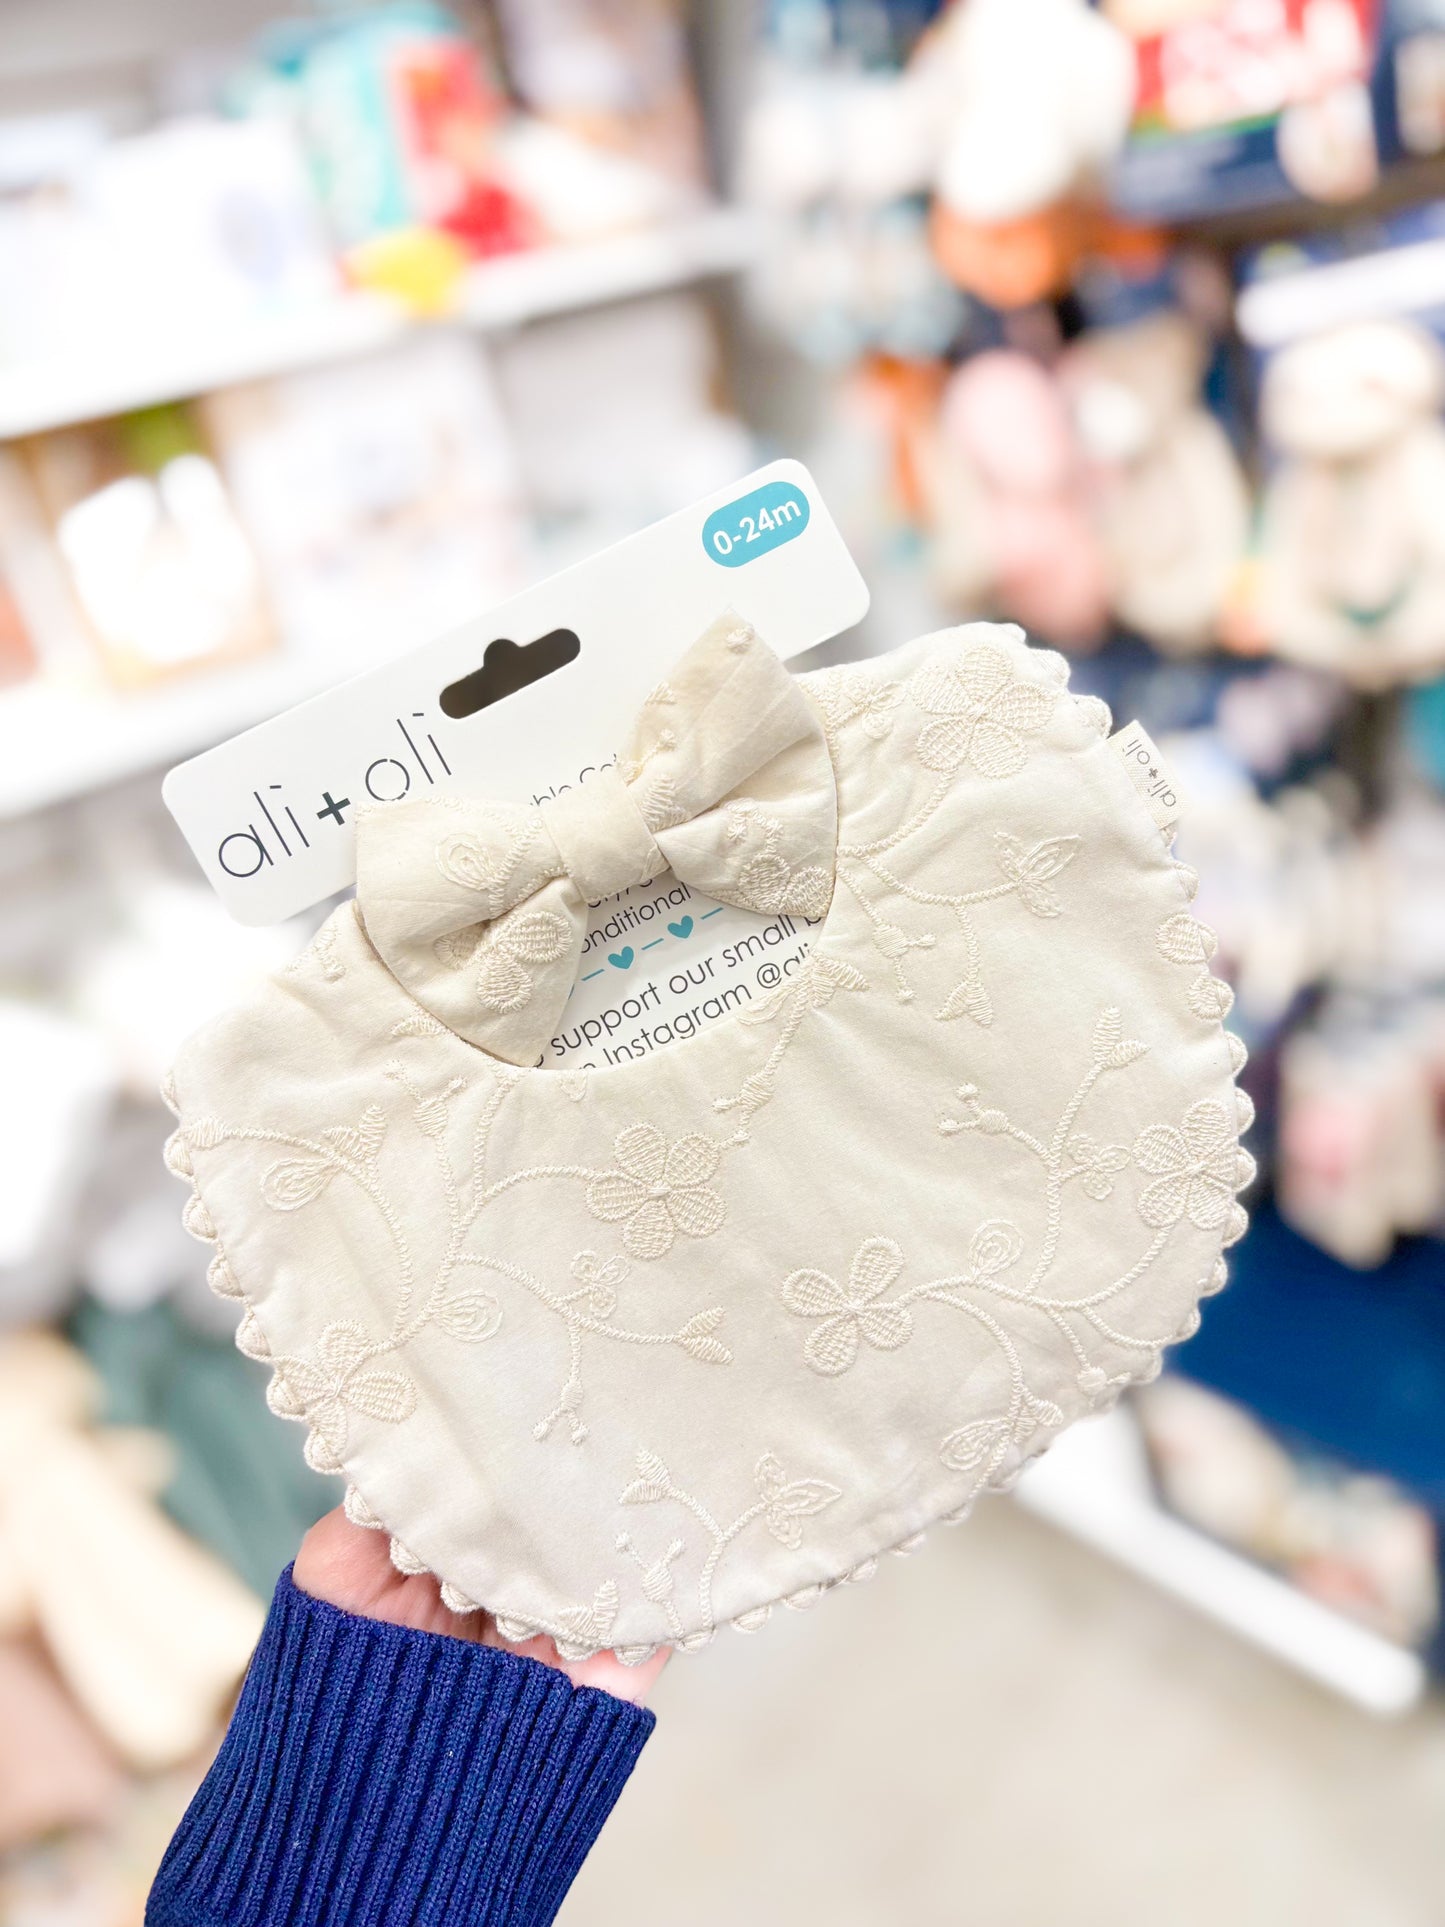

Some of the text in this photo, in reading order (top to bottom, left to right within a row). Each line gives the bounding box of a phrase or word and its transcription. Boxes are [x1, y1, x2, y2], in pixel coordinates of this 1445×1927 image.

[713, 500, 802, 555] 0-24m
[1122, 739, 1150, 765] oli
[1147, 779, 1177, 807] ali
[218, 784, 310, 878] ali
[315, 791, 351, 826] +
[550, 914, 797, 1057] support our small
[602, 984, 753, 1065] Instagram
